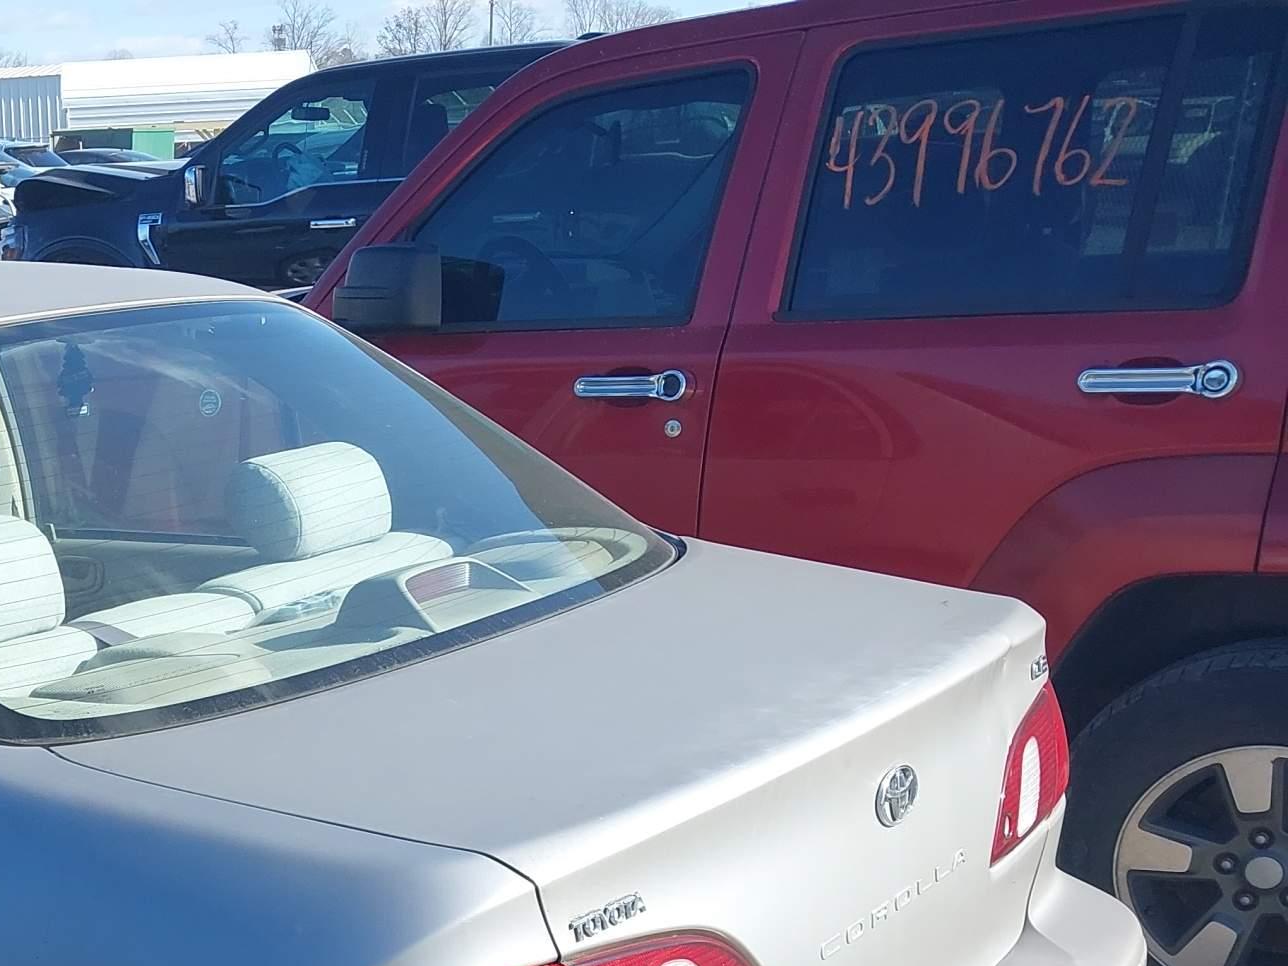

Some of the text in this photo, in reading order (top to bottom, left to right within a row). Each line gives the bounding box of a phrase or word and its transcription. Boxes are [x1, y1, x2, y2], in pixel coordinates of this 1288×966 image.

[825, 95, 1137, 208] 43996762
[568, 891, 646, 943] TOYOTA
[819, 848, 968, 961] COROLLA
